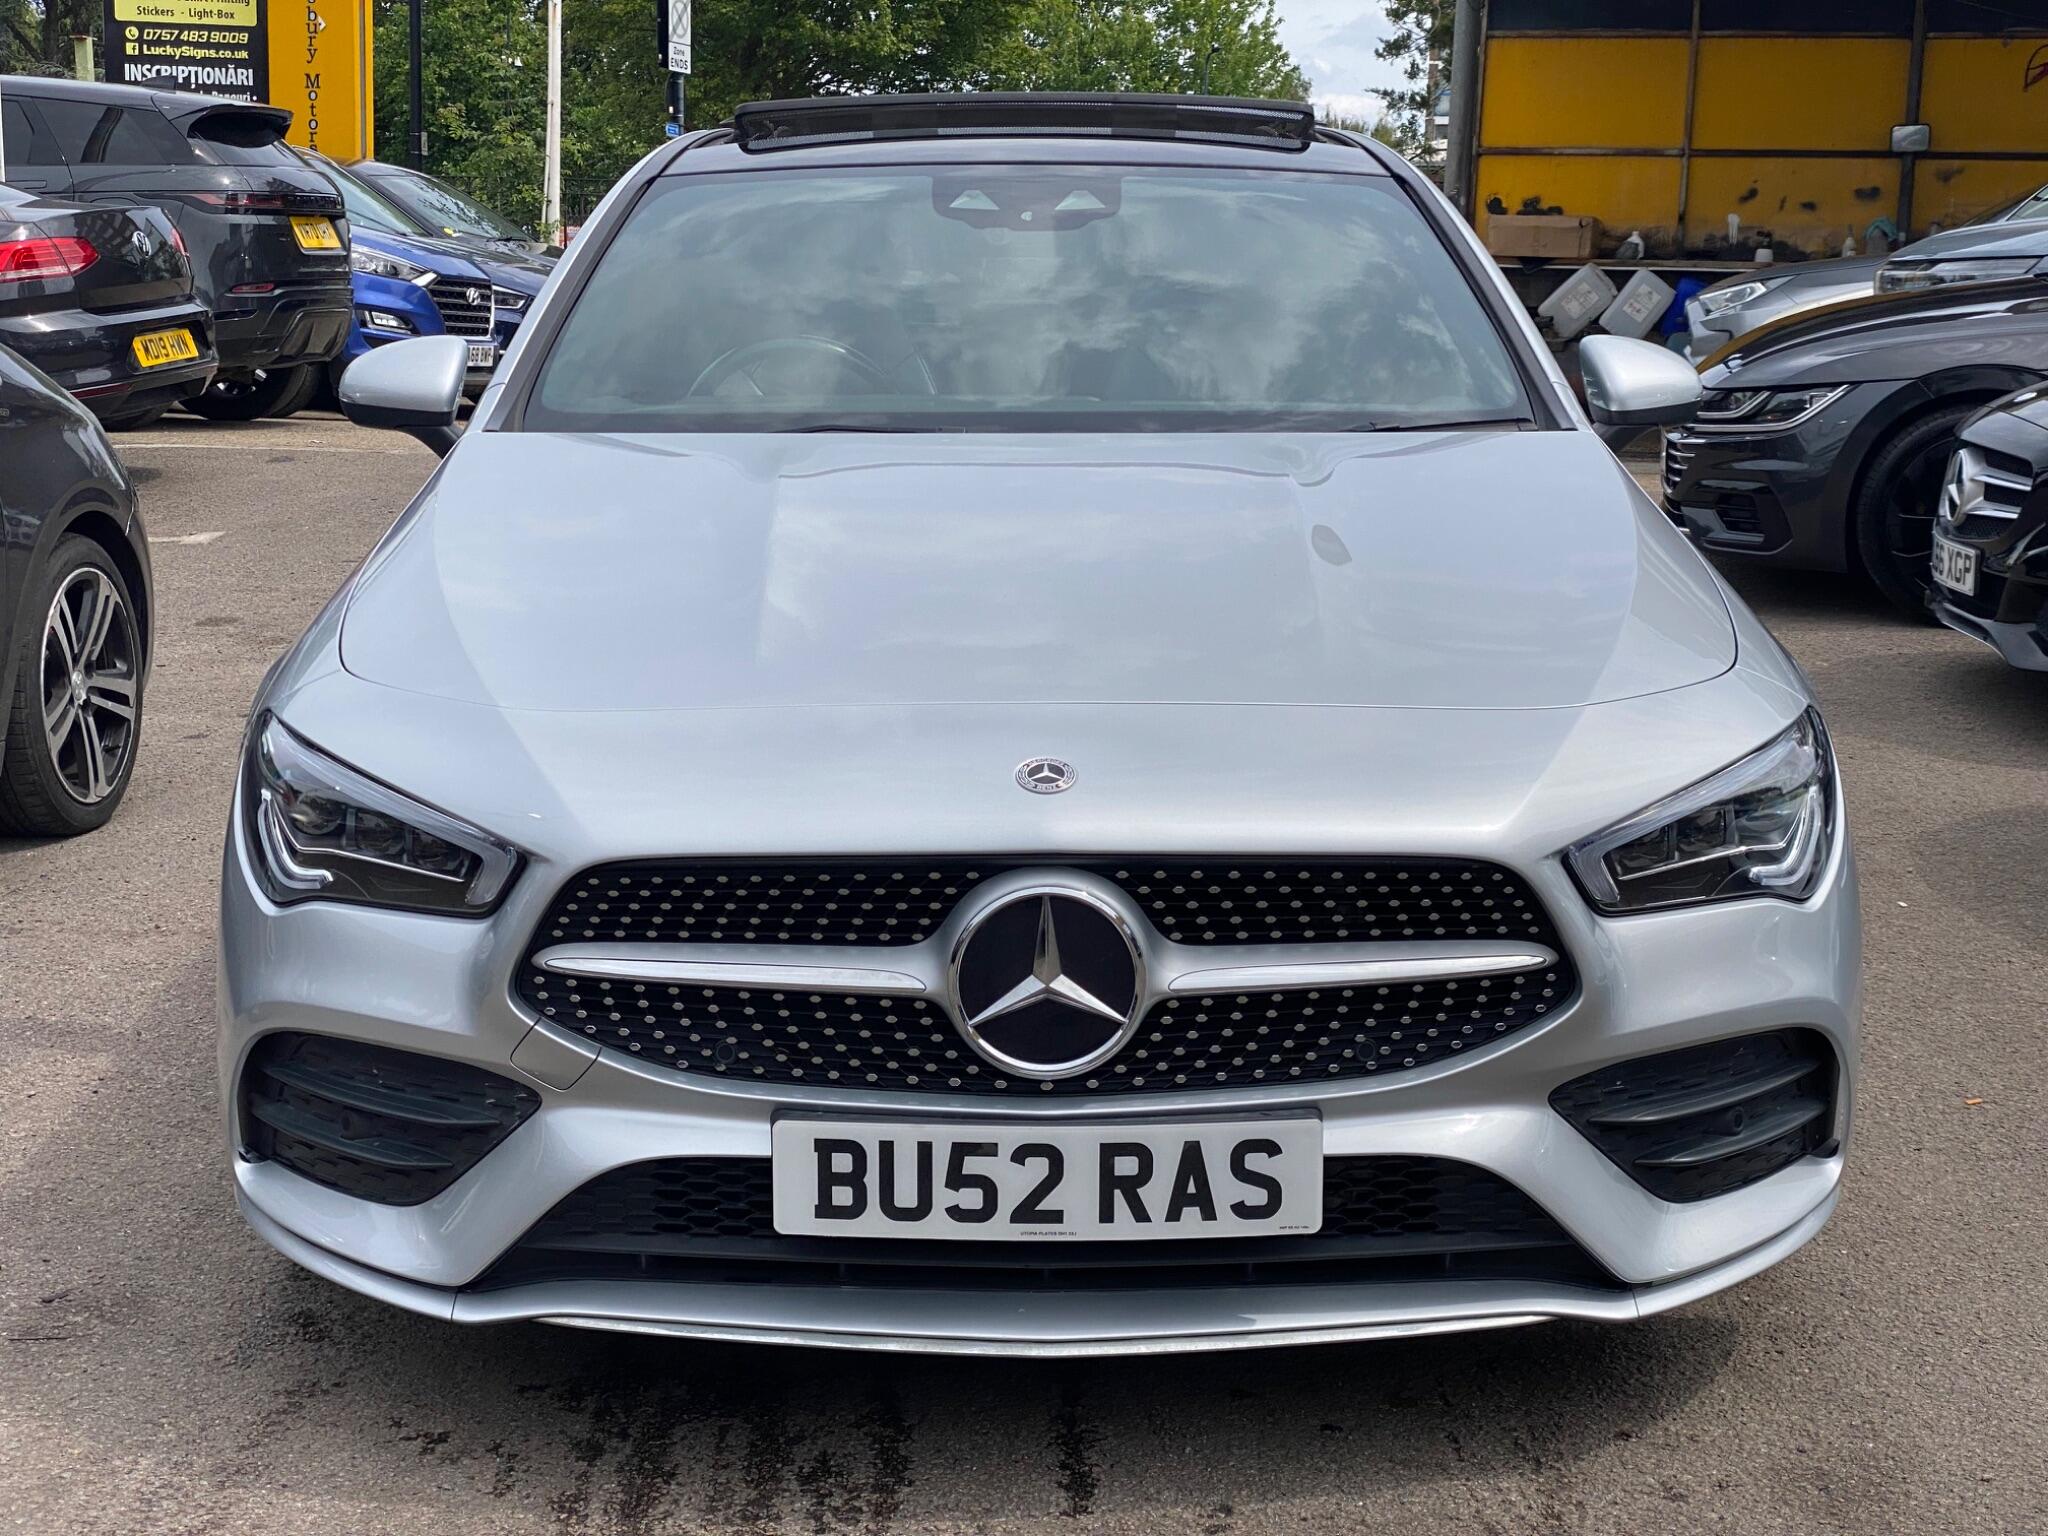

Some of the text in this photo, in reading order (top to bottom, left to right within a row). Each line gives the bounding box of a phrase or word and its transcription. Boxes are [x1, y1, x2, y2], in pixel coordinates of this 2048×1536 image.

[136, 6, 175, 17] Stickers
[188, 8, 235, 20] Light-Box
[143, 29, 249, 44] 0757 483 9009
[143, 44, 249, 60] LuckySigns.co.uk
[670, 57, 689, 70] ENDS
[140, 331, 192, 361] MD19 HWN
[1946, 546, 1972, 585] XGP
[813, 1138, 1285, 1224] BU52 RAS
